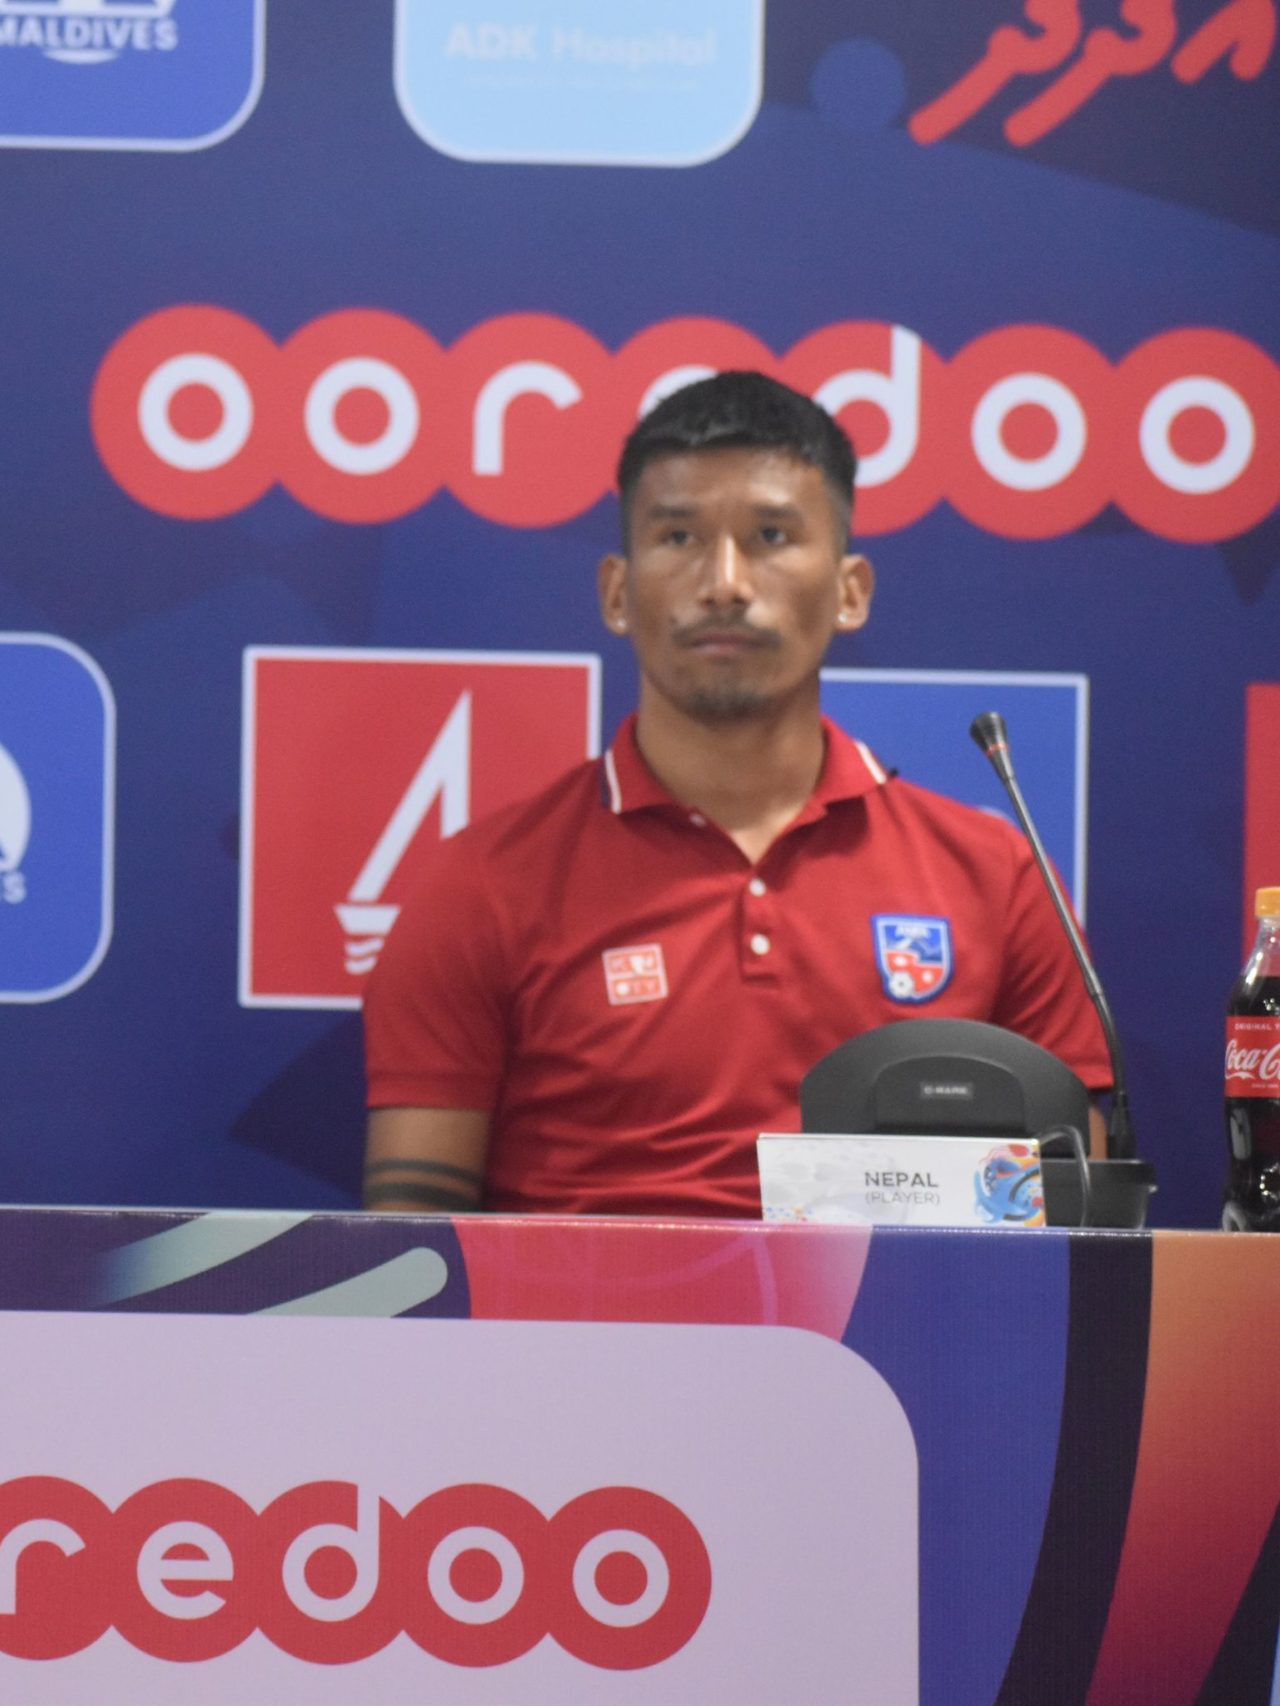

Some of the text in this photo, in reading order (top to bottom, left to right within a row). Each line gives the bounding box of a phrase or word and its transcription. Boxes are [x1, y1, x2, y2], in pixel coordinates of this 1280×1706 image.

[442, 22, 718, 70] ADK Hospital
[139, 325, 1253, 493] oordoo
[864, 1171, 940, 1188] NEPAL
[863, 1190, 941, 1206] (PLAYER)
